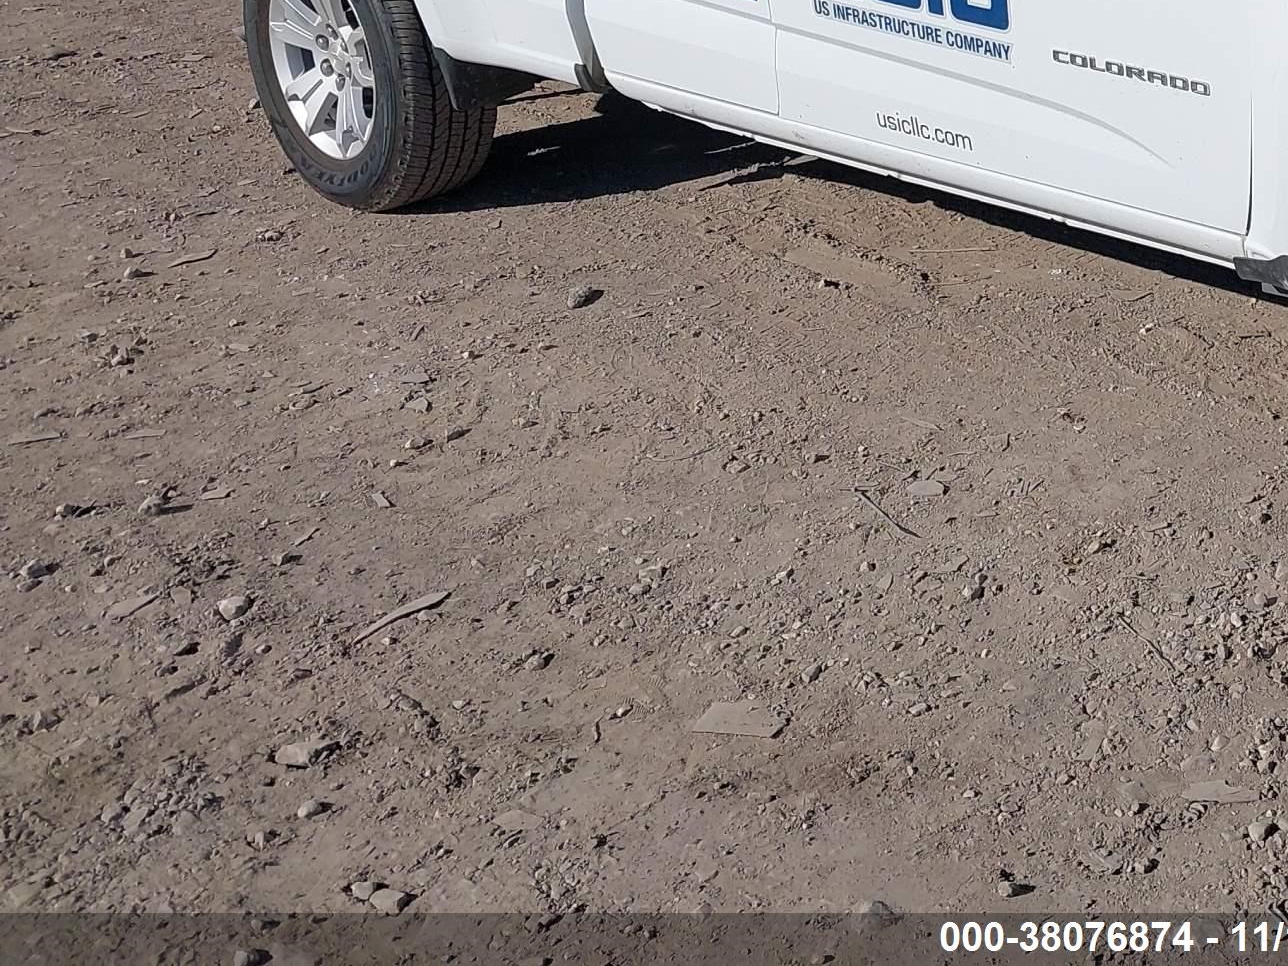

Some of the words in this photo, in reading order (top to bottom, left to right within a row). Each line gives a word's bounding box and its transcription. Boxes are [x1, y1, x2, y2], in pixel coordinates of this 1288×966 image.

[833, 3, 943, 45] INFRASTRUCTURE
[945, 31, 1011, 61] COMPANY
[1052, 49, 1211, 96] COLORADO
[876, 111, 974, 151] usicllc.com
